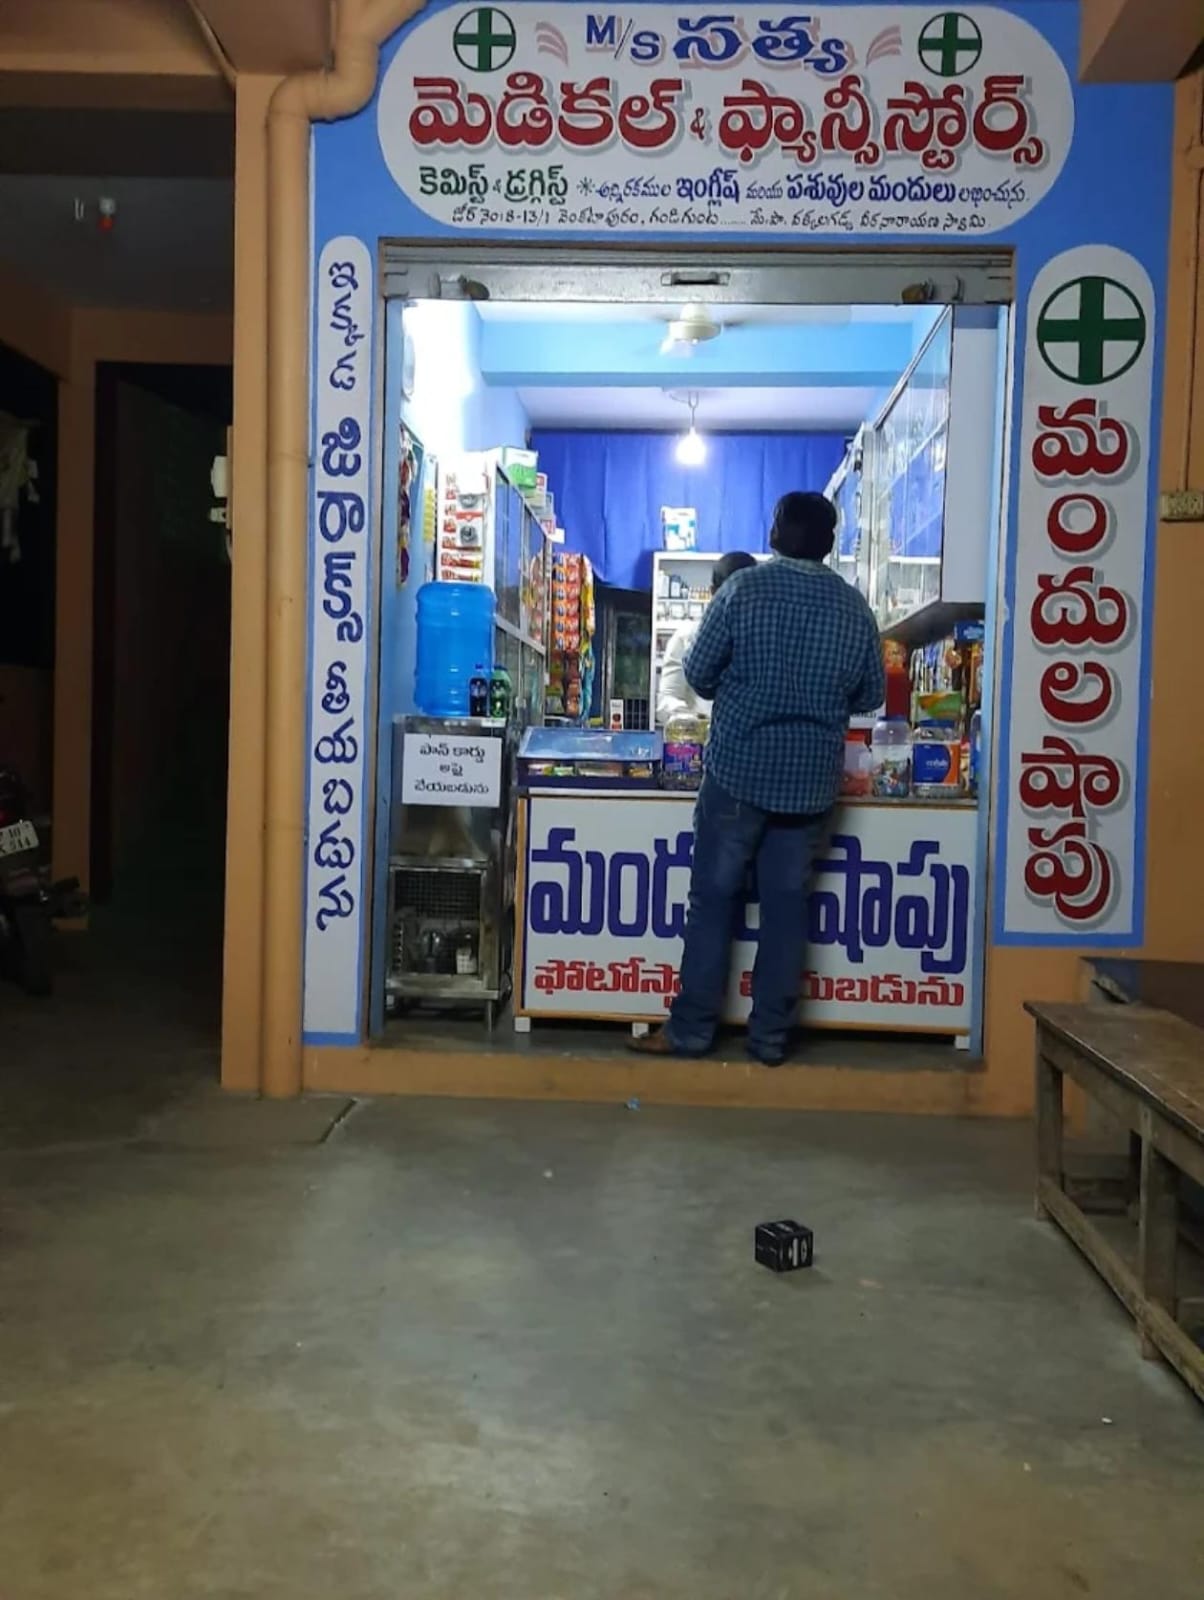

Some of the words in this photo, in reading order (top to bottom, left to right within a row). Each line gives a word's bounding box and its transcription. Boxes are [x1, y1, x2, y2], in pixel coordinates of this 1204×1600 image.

[585, 15, 660, 61] M/s
[673, 15, 848, 74] సత్య
[409, 72, 684, 149] మెడికల్
[690, 107, 707, 141] &
[419, 164, 489, 204] కెమిస్ట్
[676, 167, 740, 207] ఇంగ్లీష్
[786, 172, 865, 207] పశువుల
[869, 175, 957, 203] మందులు
[328, 261, 365, 391] ఇక్కడ
